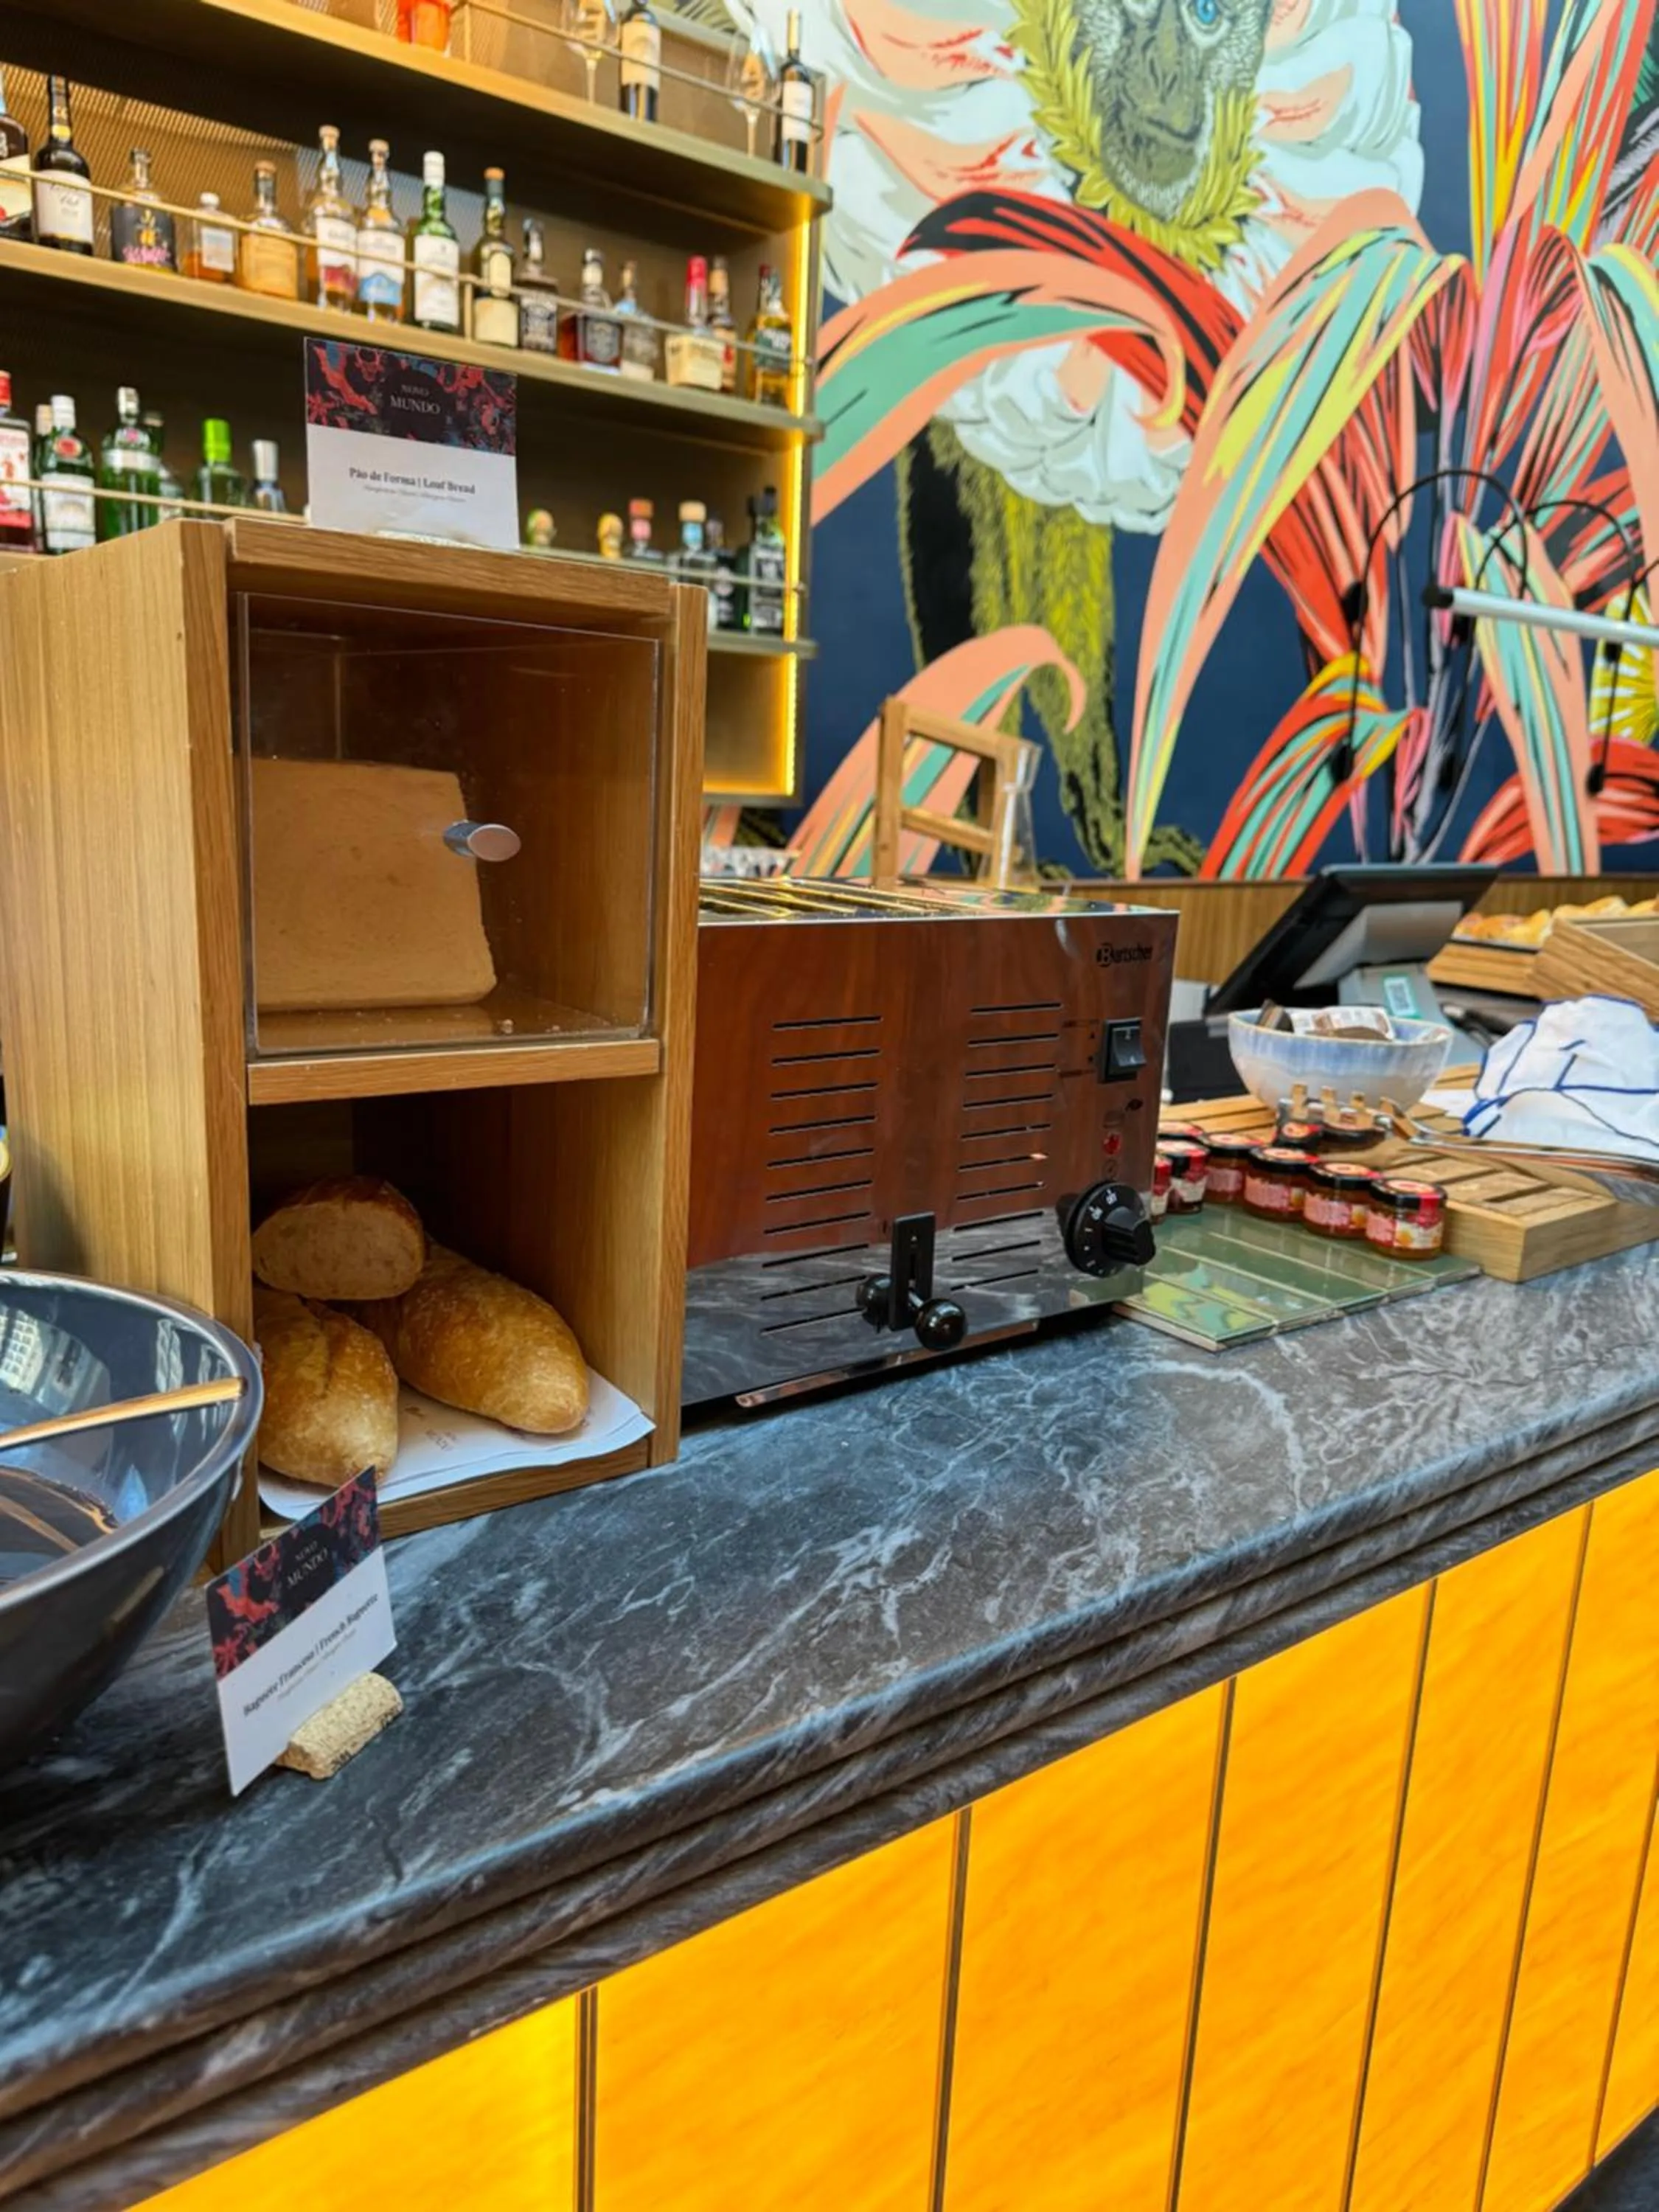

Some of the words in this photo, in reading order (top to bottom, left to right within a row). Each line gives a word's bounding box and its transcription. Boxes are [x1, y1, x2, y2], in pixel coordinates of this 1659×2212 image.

[390, 394, 441, 414] MUNDO
[370, 470, 381, 481] de
[383, 471, 416, 486] Forma
[423, 478, 446, 490] Loaf
[447, 481, 476, 495] Bread
[287, 1547, 328, 1590] MUNDO
[319, 1621, 347, 1651] French
